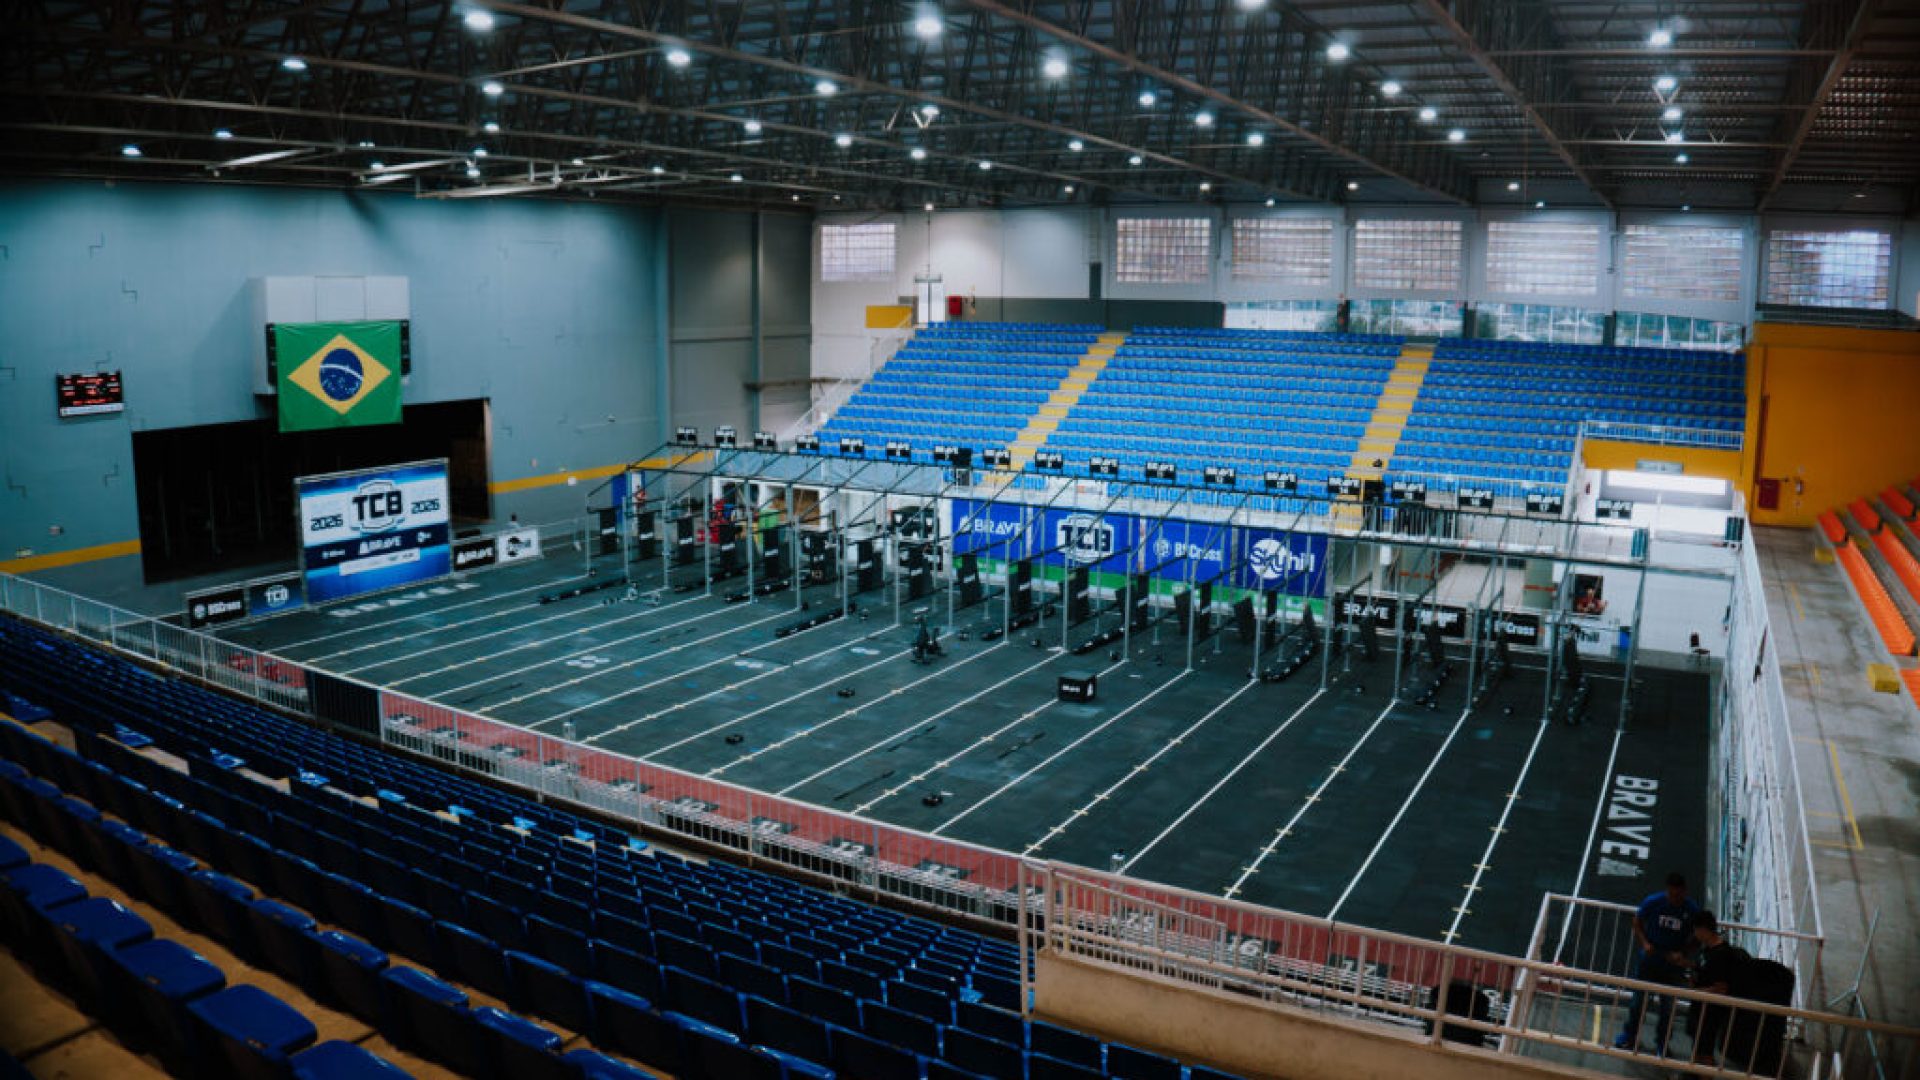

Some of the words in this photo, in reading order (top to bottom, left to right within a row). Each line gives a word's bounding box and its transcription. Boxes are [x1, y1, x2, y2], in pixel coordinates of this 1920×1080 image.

[352, 490, 402, 521] TCB
[1060, 525, 1111, 552] TCB
[1600, 775, 1659, 859] BRAVE
